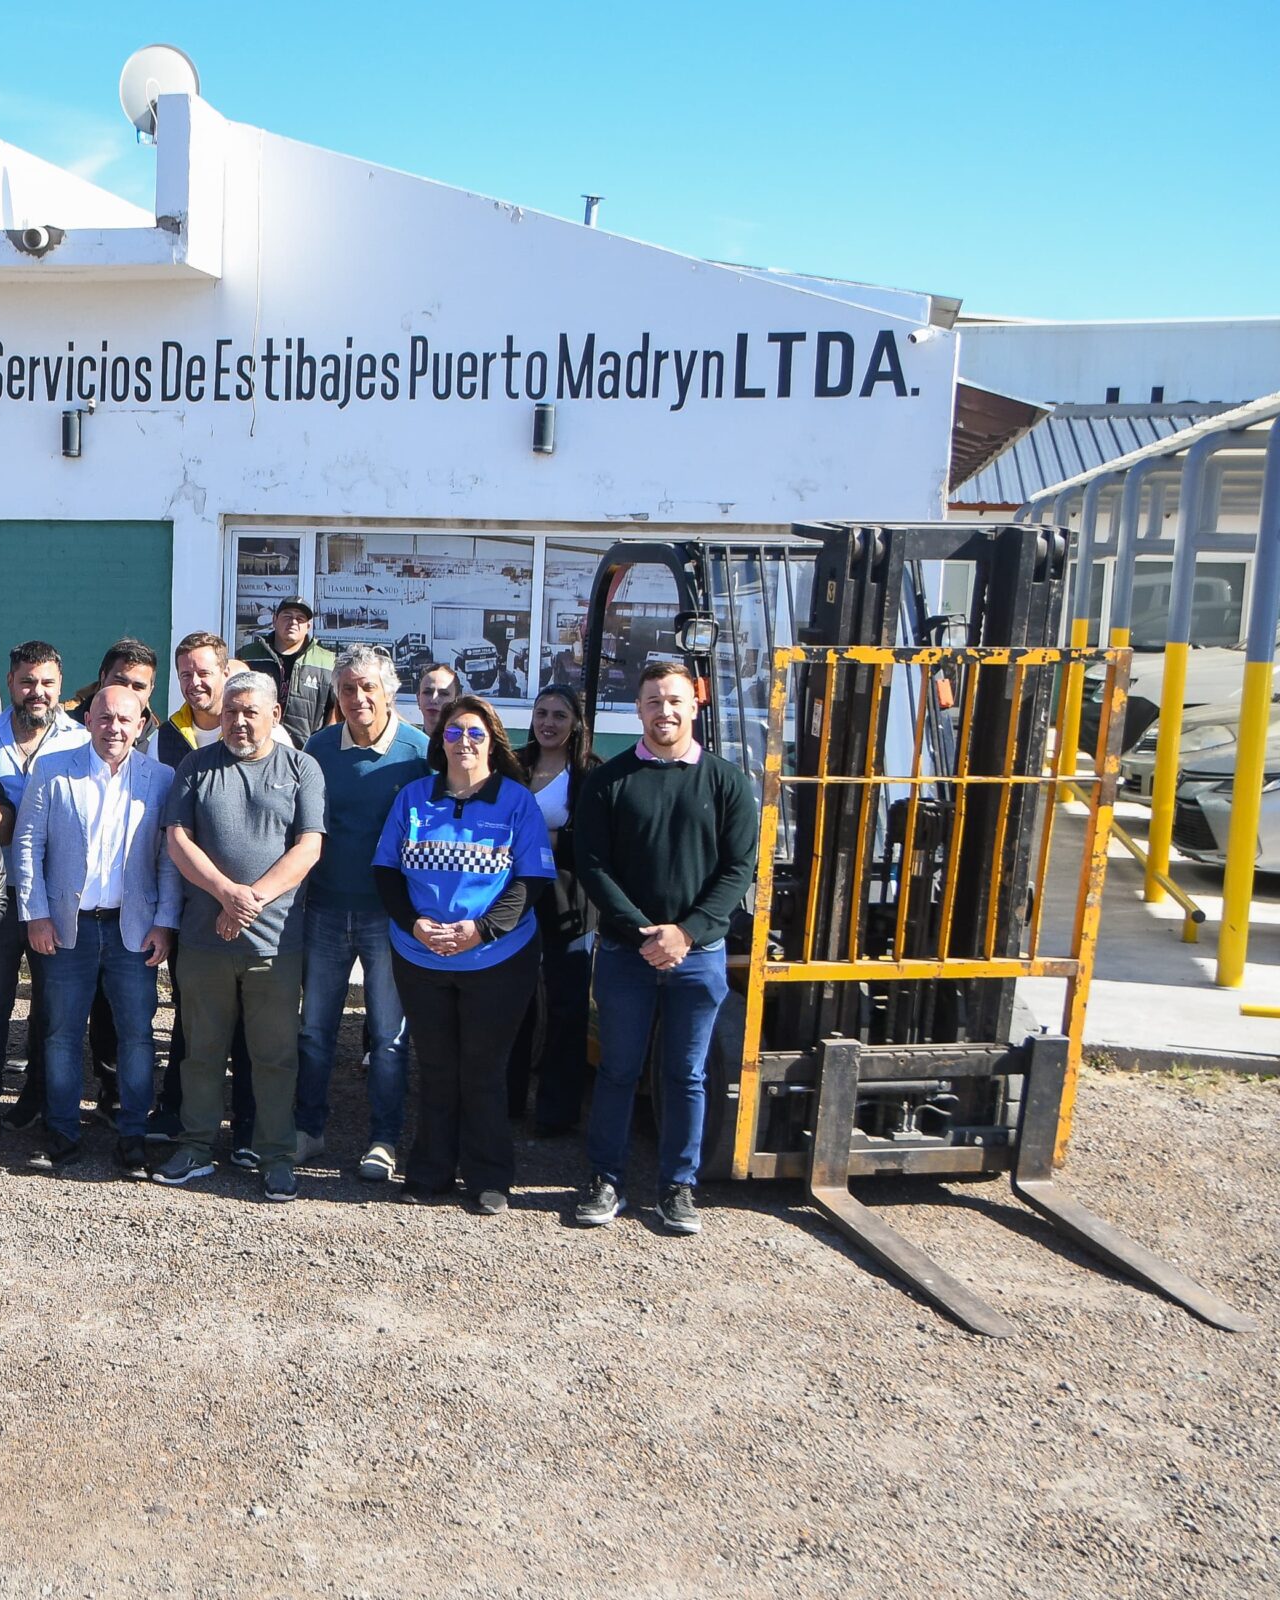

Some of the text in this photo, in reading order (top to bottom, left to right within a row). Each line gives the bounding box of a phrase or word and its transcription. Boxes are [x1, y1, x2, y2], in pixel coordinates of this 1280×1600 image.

[161, 341, 206, 403] De
[213, 337, 400, 410] Estibajes
[410, 335, 548, 401] Puerto
[557, 332, 724, 411] Madryn
[734, 330, 920, 398] LTDA.
